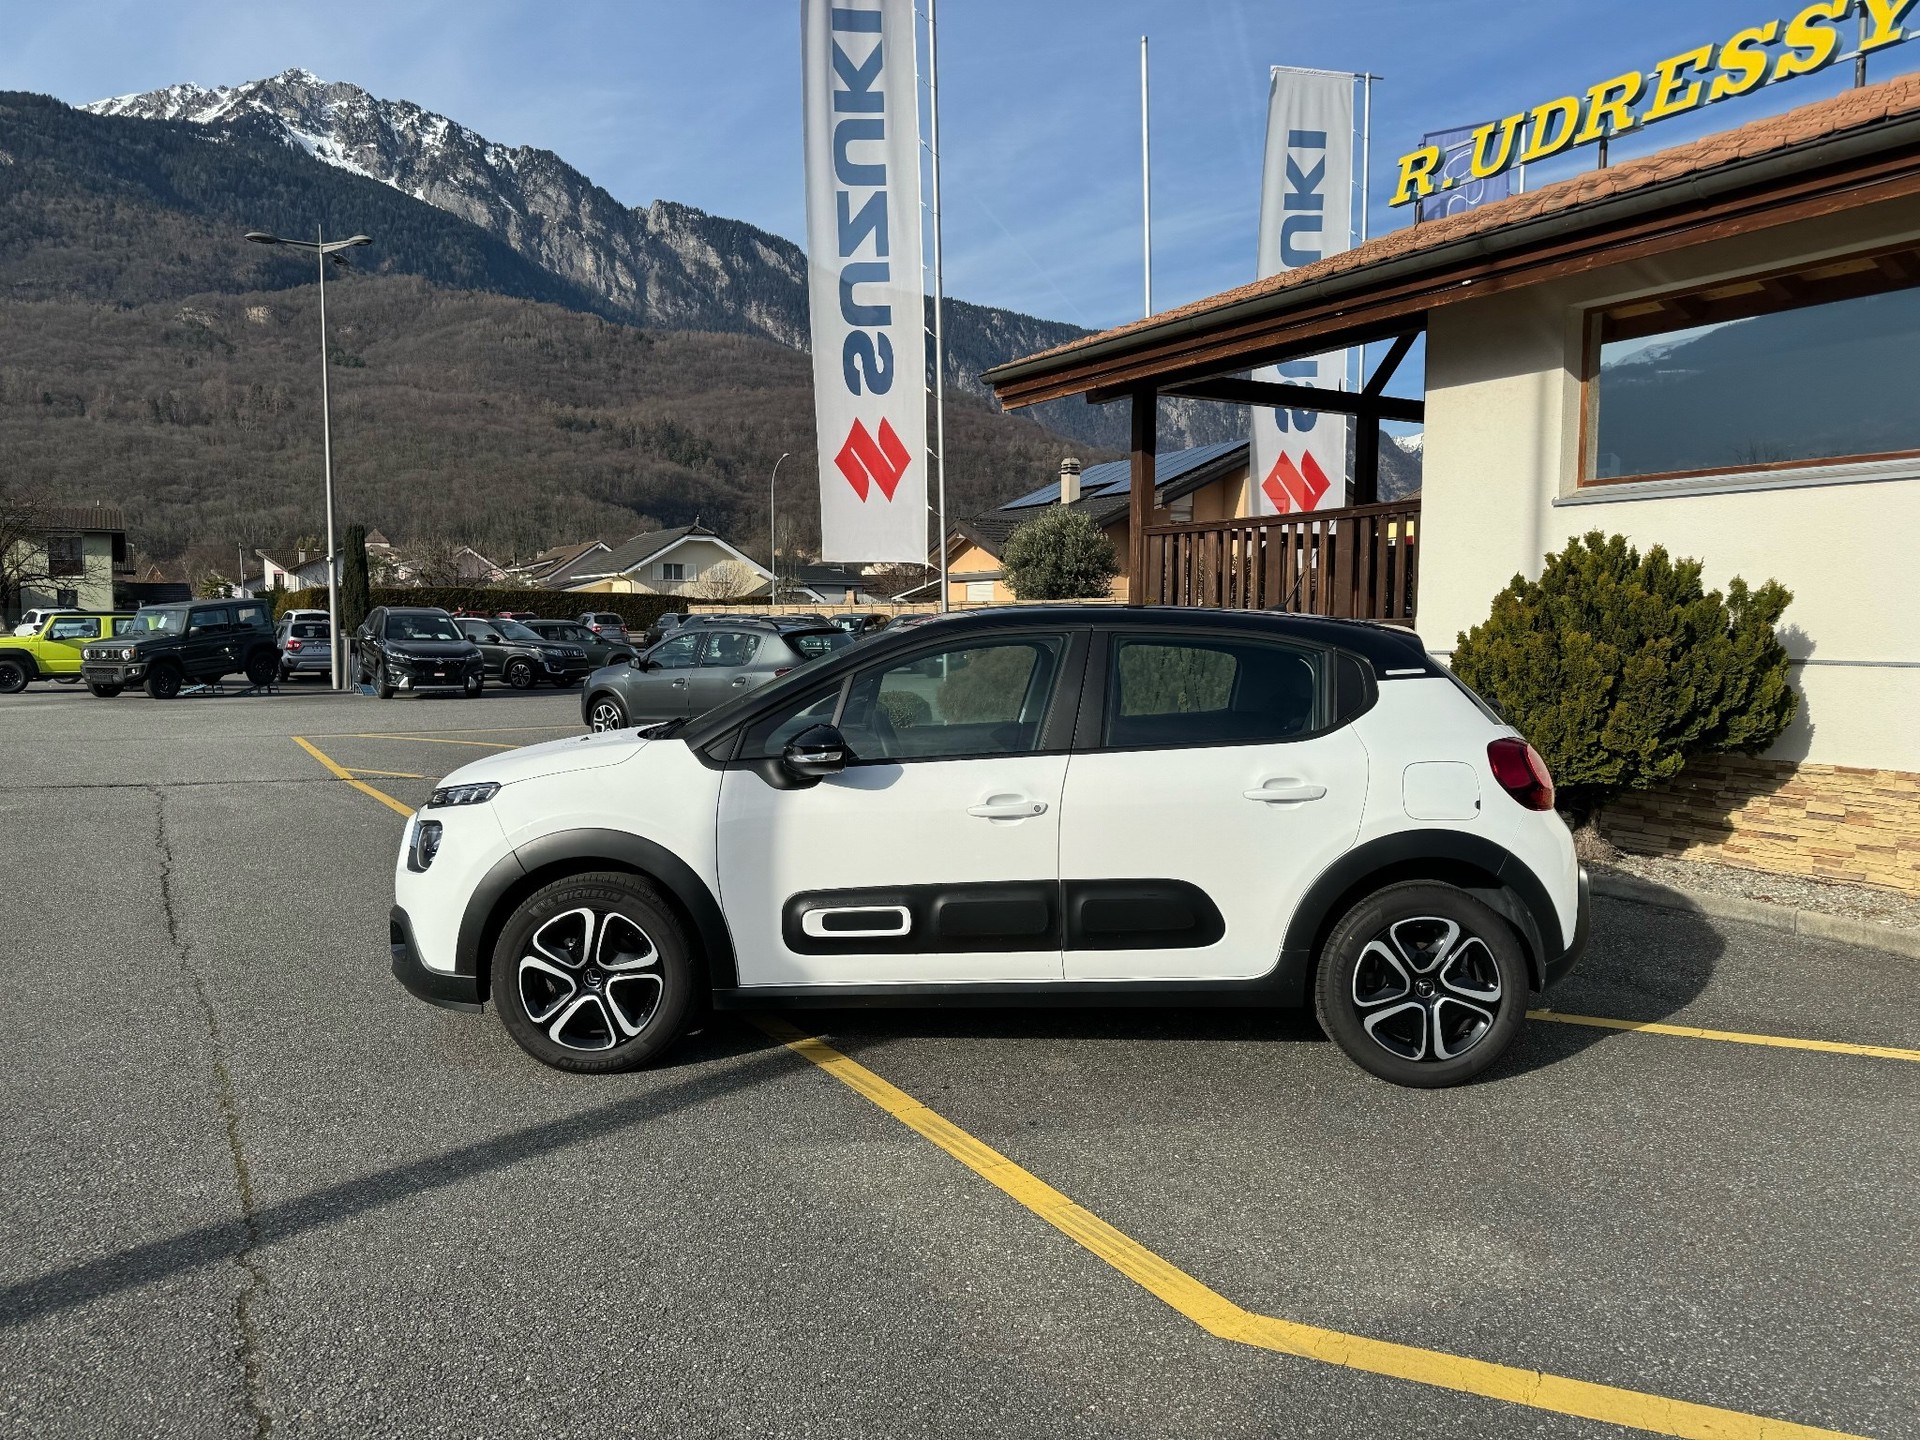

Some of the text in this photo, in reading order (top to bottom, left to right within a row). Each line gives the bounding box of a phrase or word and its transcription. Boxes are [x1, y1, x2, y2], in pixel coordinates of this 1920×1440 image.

[1389, 0, 1912, 207] R. UDRESSY
[555, 888, 622, 903] MICHELIN
